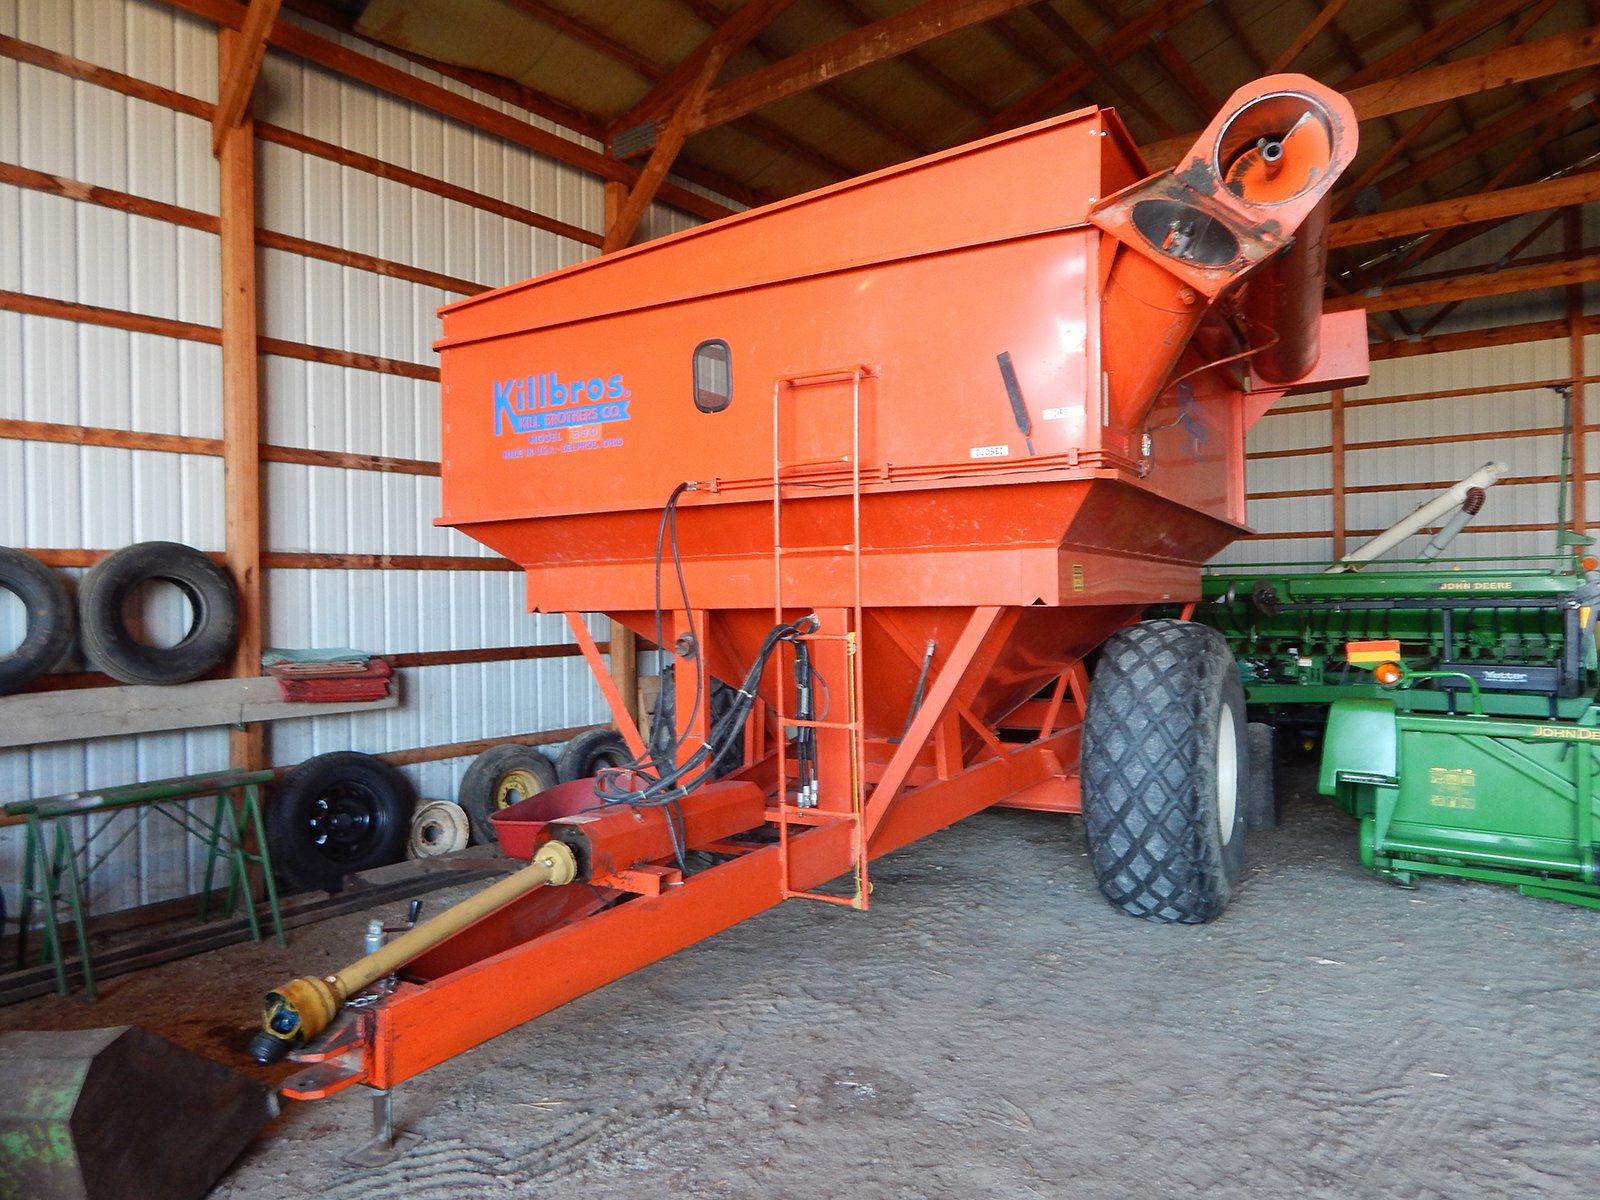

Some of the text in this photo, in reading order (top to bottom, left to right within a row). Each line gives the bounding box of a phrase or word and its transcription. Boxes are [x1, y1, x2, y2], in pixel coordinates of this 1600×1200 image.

[519, 417, 540, 429] KILL
[545, 408, 599, 426] BROTHERS
[529, 432, 561, 444] MODEL
[1439, 582, 1512, 590] JOHN DEERE
[1533, 726, 1576, 739] JOHN
